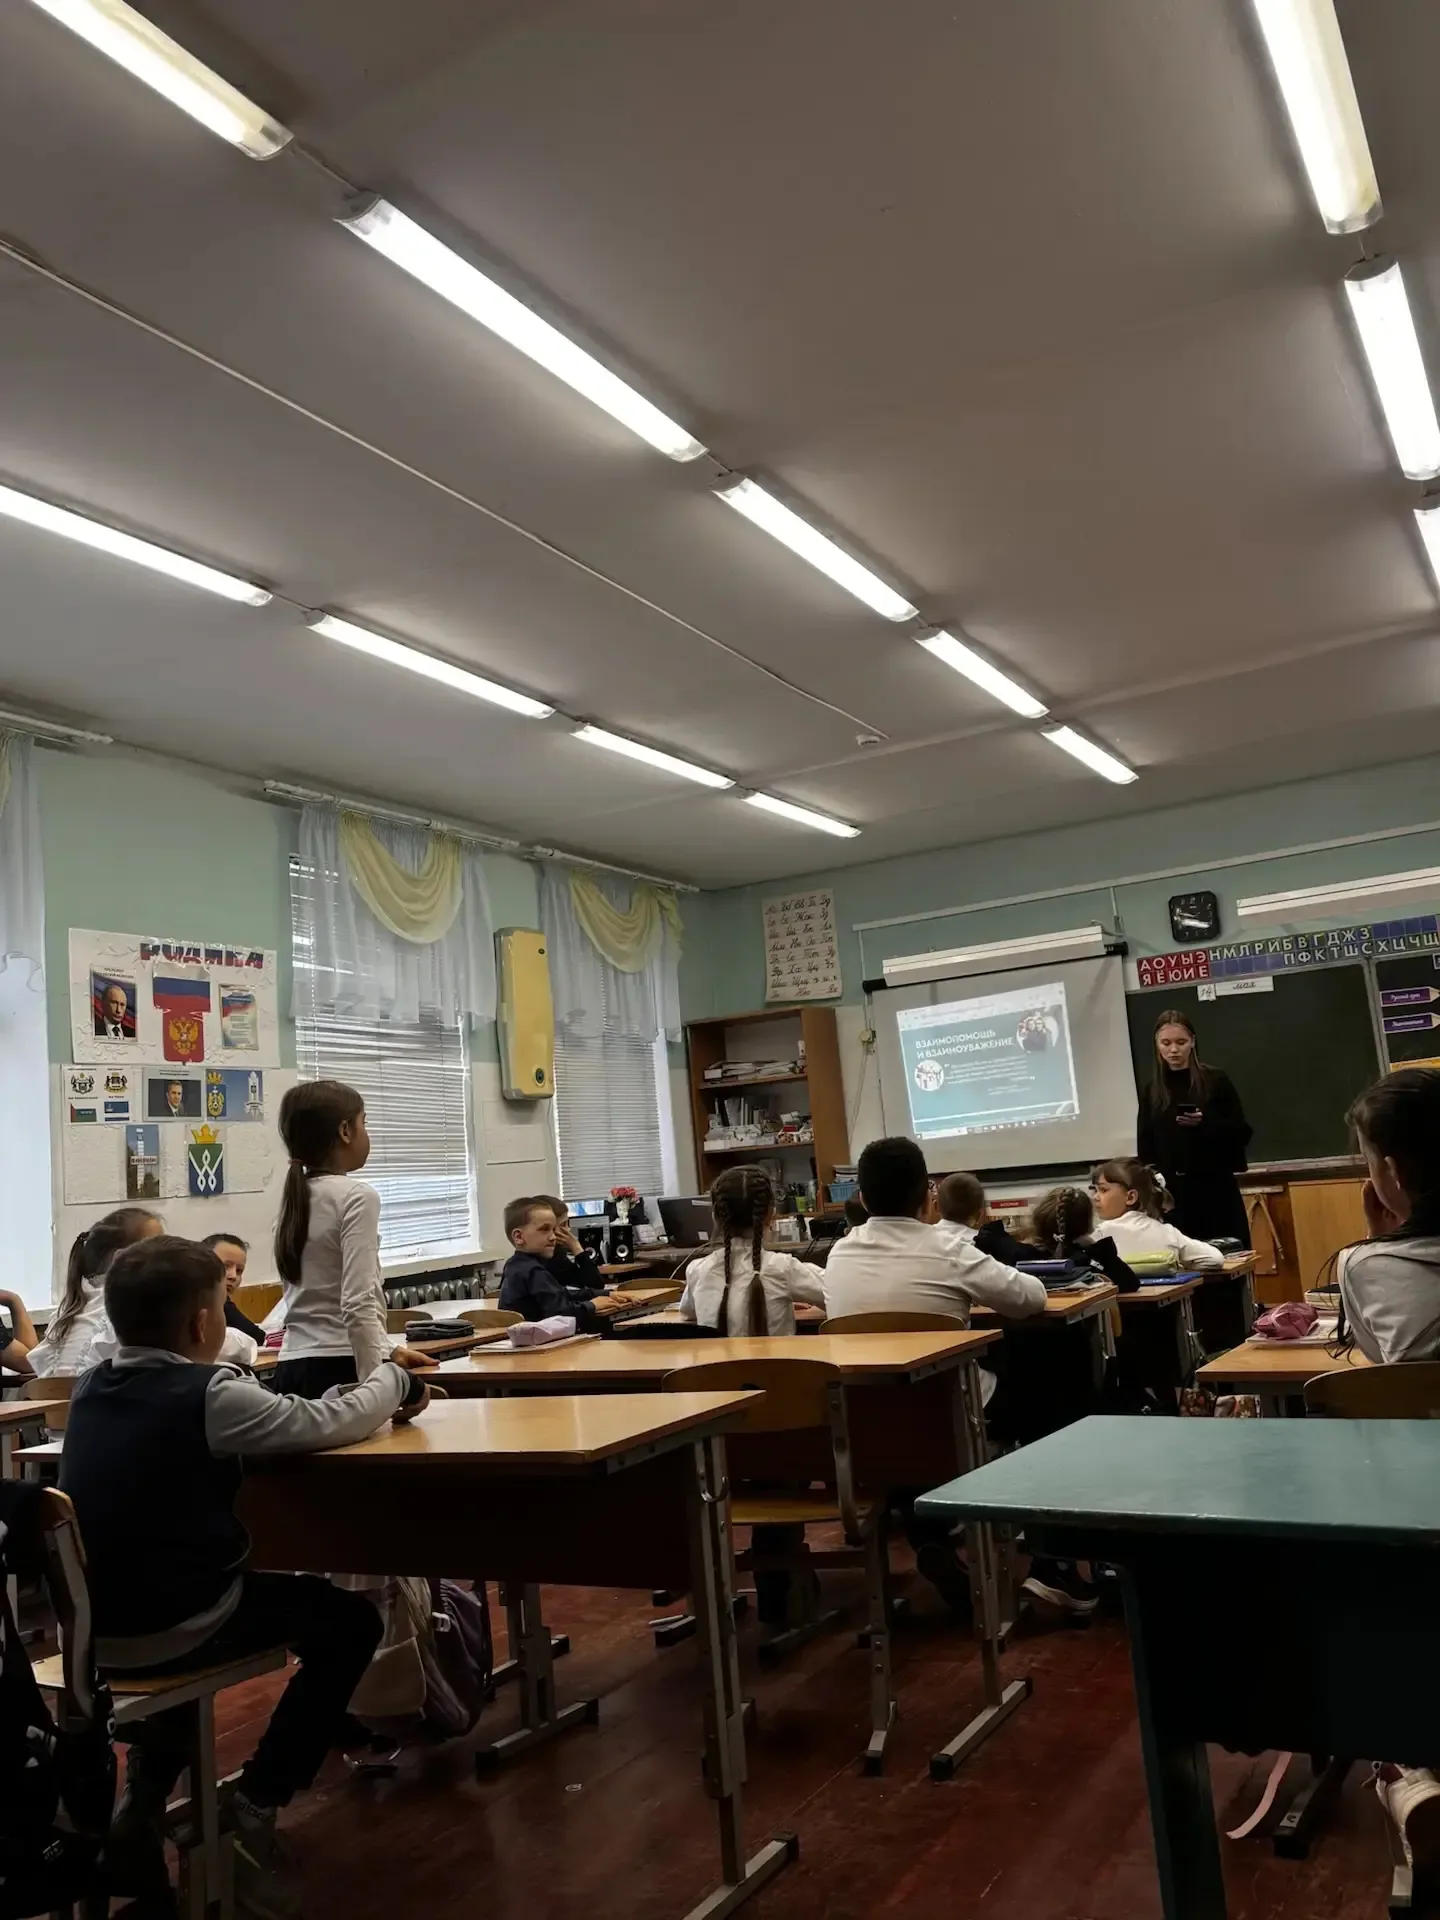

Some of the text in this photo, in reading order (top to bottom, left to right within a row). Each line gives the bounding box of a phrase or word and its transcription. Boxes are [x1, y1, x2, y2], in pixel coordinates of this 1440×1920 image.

[140, 936, 264, 969] РОДИНА
[915, 1029, 996, 1049] ВЗАИМОПОМОЩЬ
[917, 1036, 1014, 1059] И ВЗАИМОУВАЖЕНИЕ
